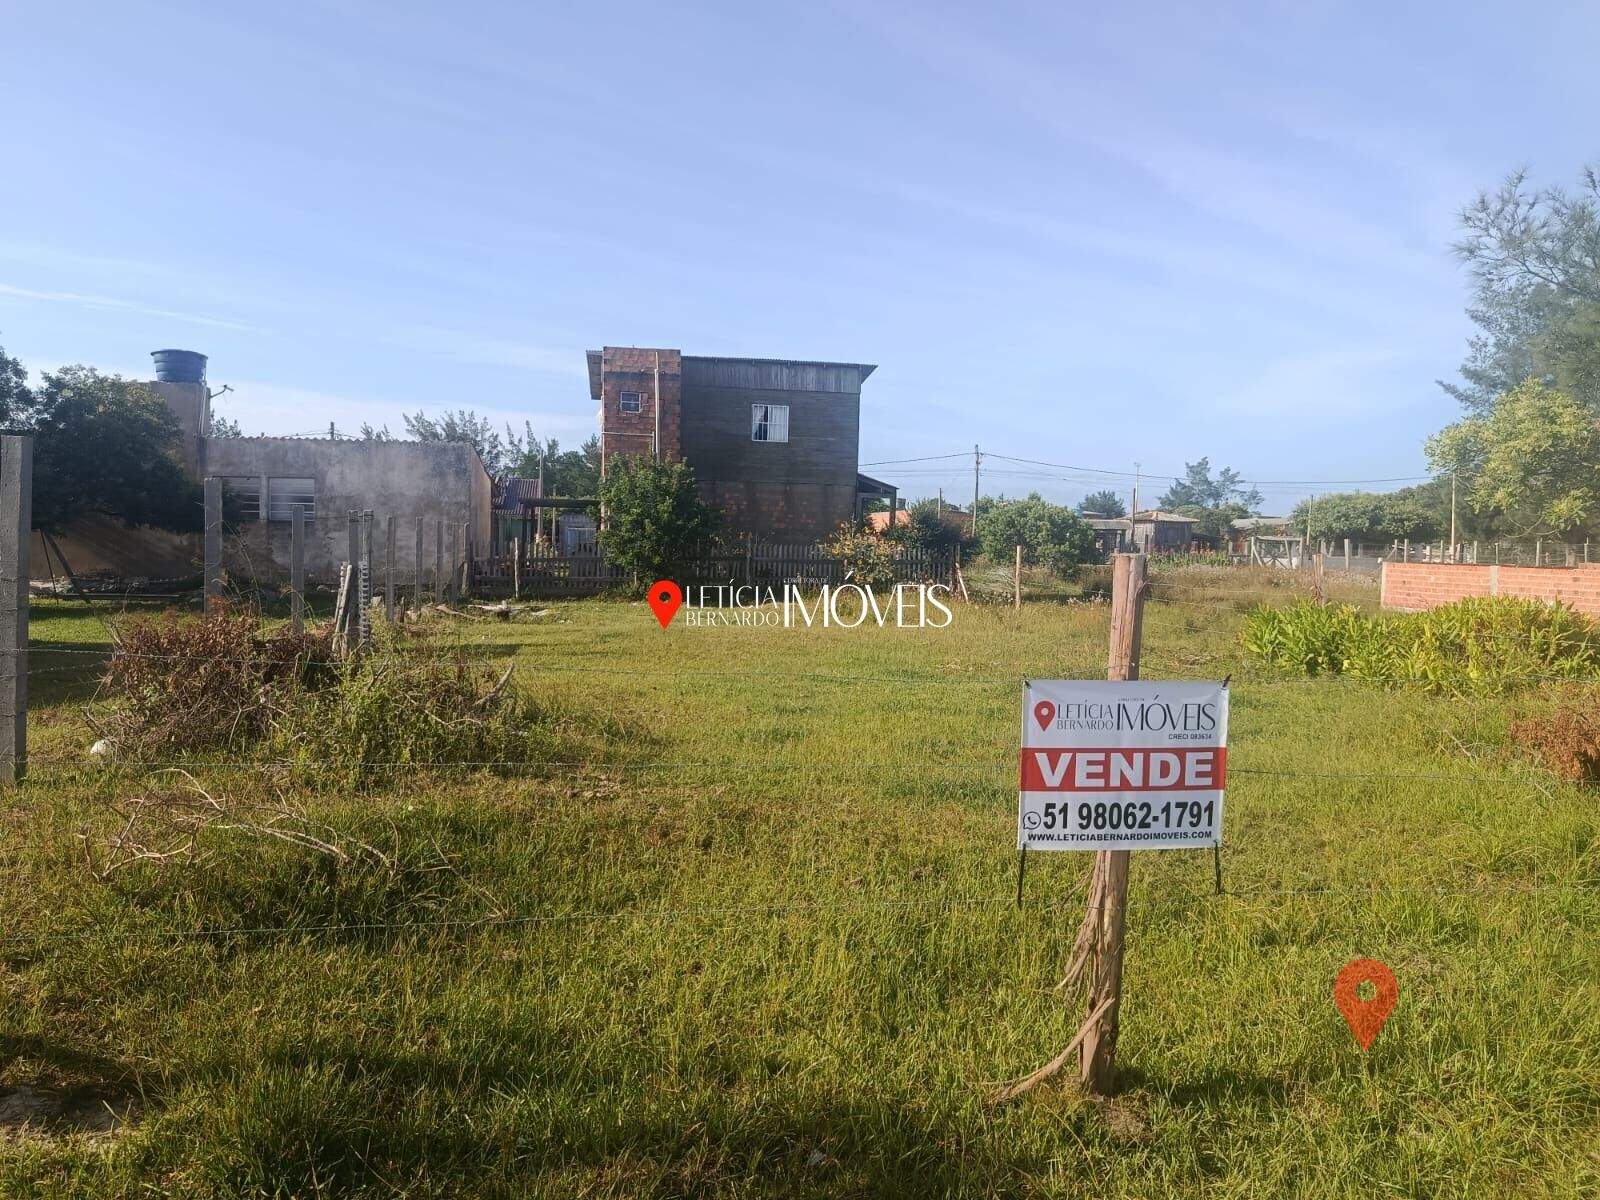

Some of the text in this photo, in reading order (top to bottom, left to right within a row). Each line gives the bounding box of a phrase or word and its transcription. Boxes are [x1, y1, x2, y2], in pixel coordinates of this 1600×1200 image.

[1057, 699, 1114, 720] LETÍCIA
[1116, 694, 1216, 731] IMÓVEIS
[1056, 720, 1114, 731] BERNARDO
[1034, 751, 1214, 788] VENDE
[1043, 800, 1214, 830] 51 98062-1791
[1027, 830, 1212, 842] WWW.LETICIABERNARDOIMOVEIS.COM
